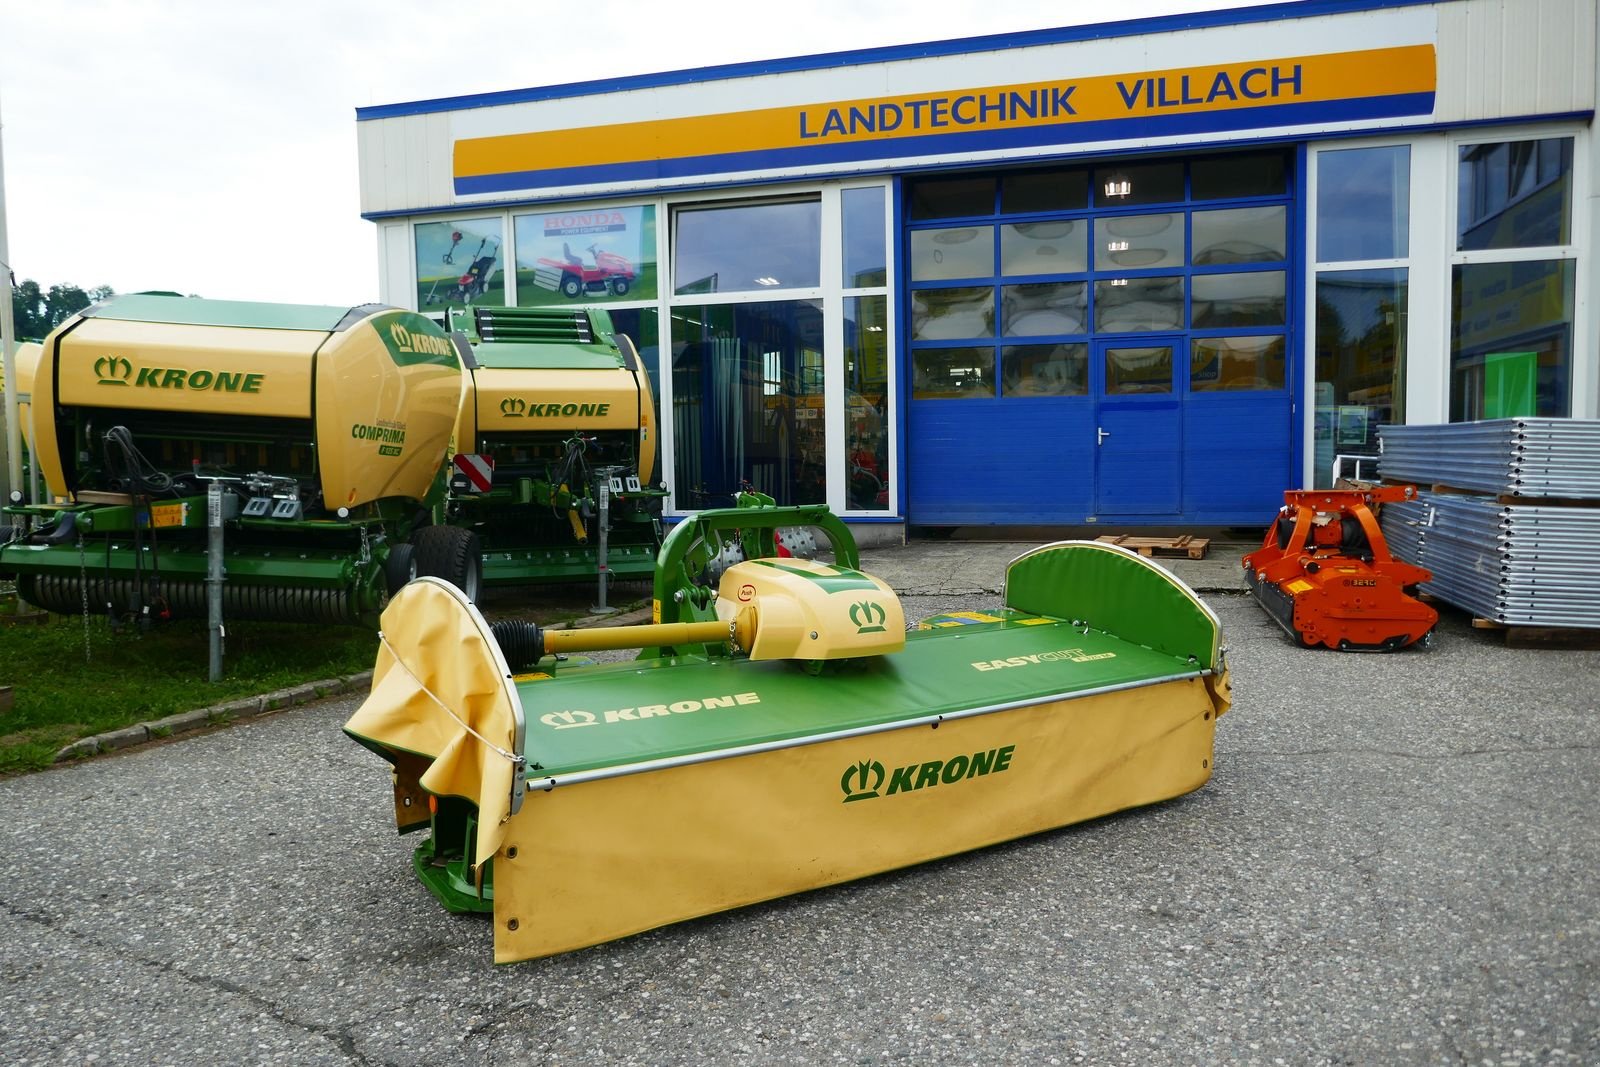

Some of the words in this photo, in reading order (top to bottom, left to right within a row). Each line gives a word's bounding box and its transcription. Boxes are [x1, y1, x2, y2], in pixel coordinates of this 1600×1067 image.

[800, 86, 1077, 139] LANDTECHNIK
[1116, 64, 1302, 110] VILLACH
[544, 212, 625, 228] HONDA
[411, 333, 453, 357] KRONE
[135, 367, 266, 394] KRONE
[528, 403, 610, 417] KRONE
[352, 423, 405, 443] COMPRIMA
[604, 692, 761, 724] KRONE
[886, 745, 1016, 796] KRONE
